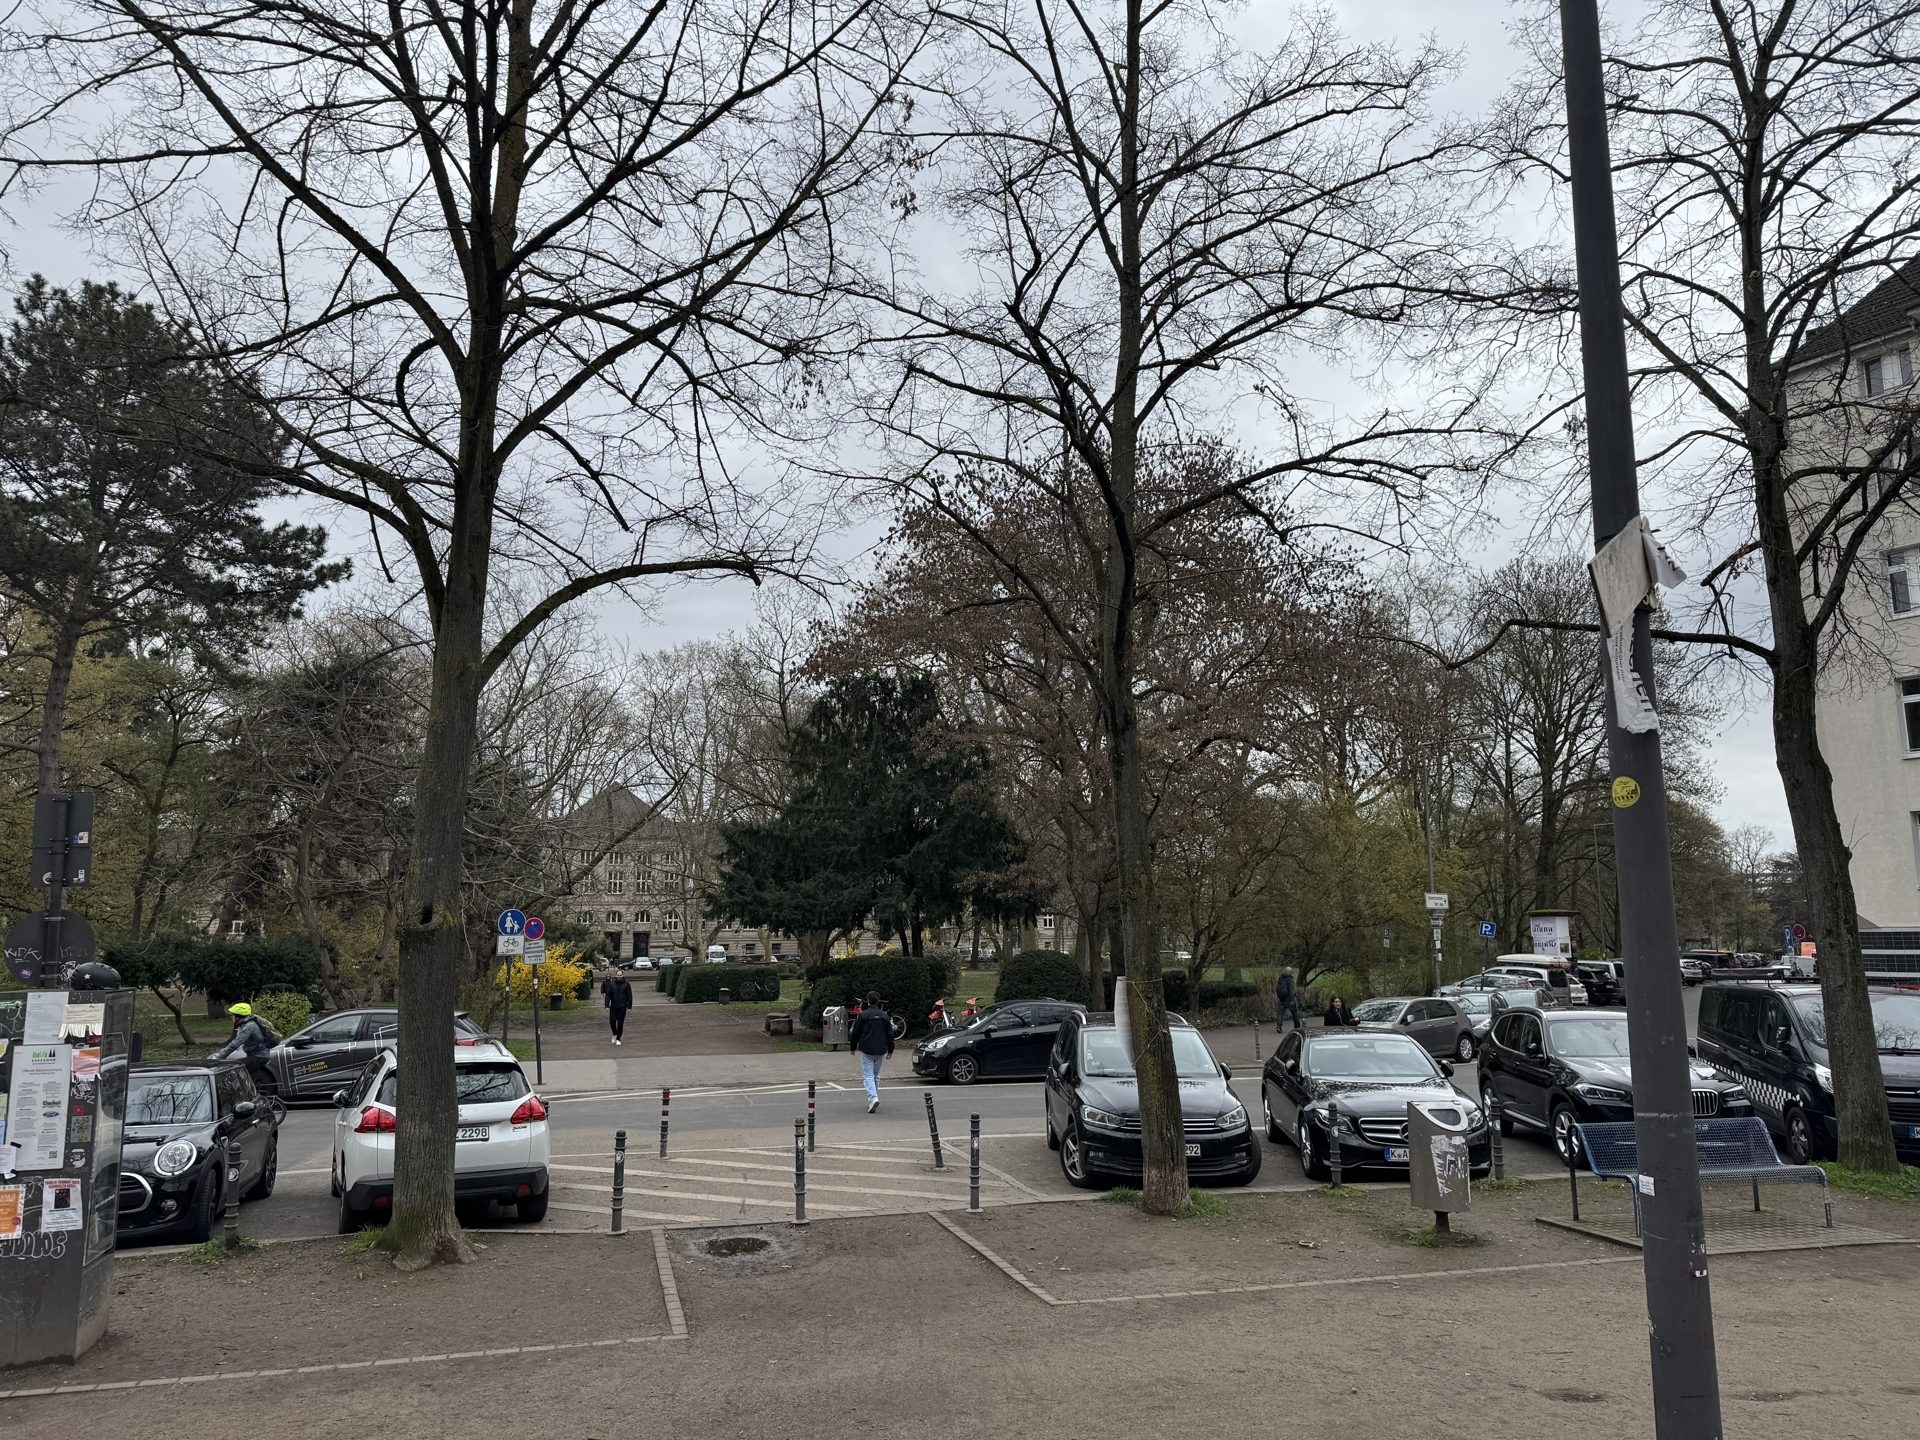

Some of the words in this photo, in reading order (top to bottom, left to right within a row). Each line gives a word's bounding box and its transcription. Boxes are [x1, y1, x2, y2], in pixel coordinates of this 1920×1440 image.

[1482, 923, 1491, 935] P
[1785, 929, 1790, 943] P
[461, 1128, 488, 1138] 2298
[1390, 1149, 1397, 1158] K
